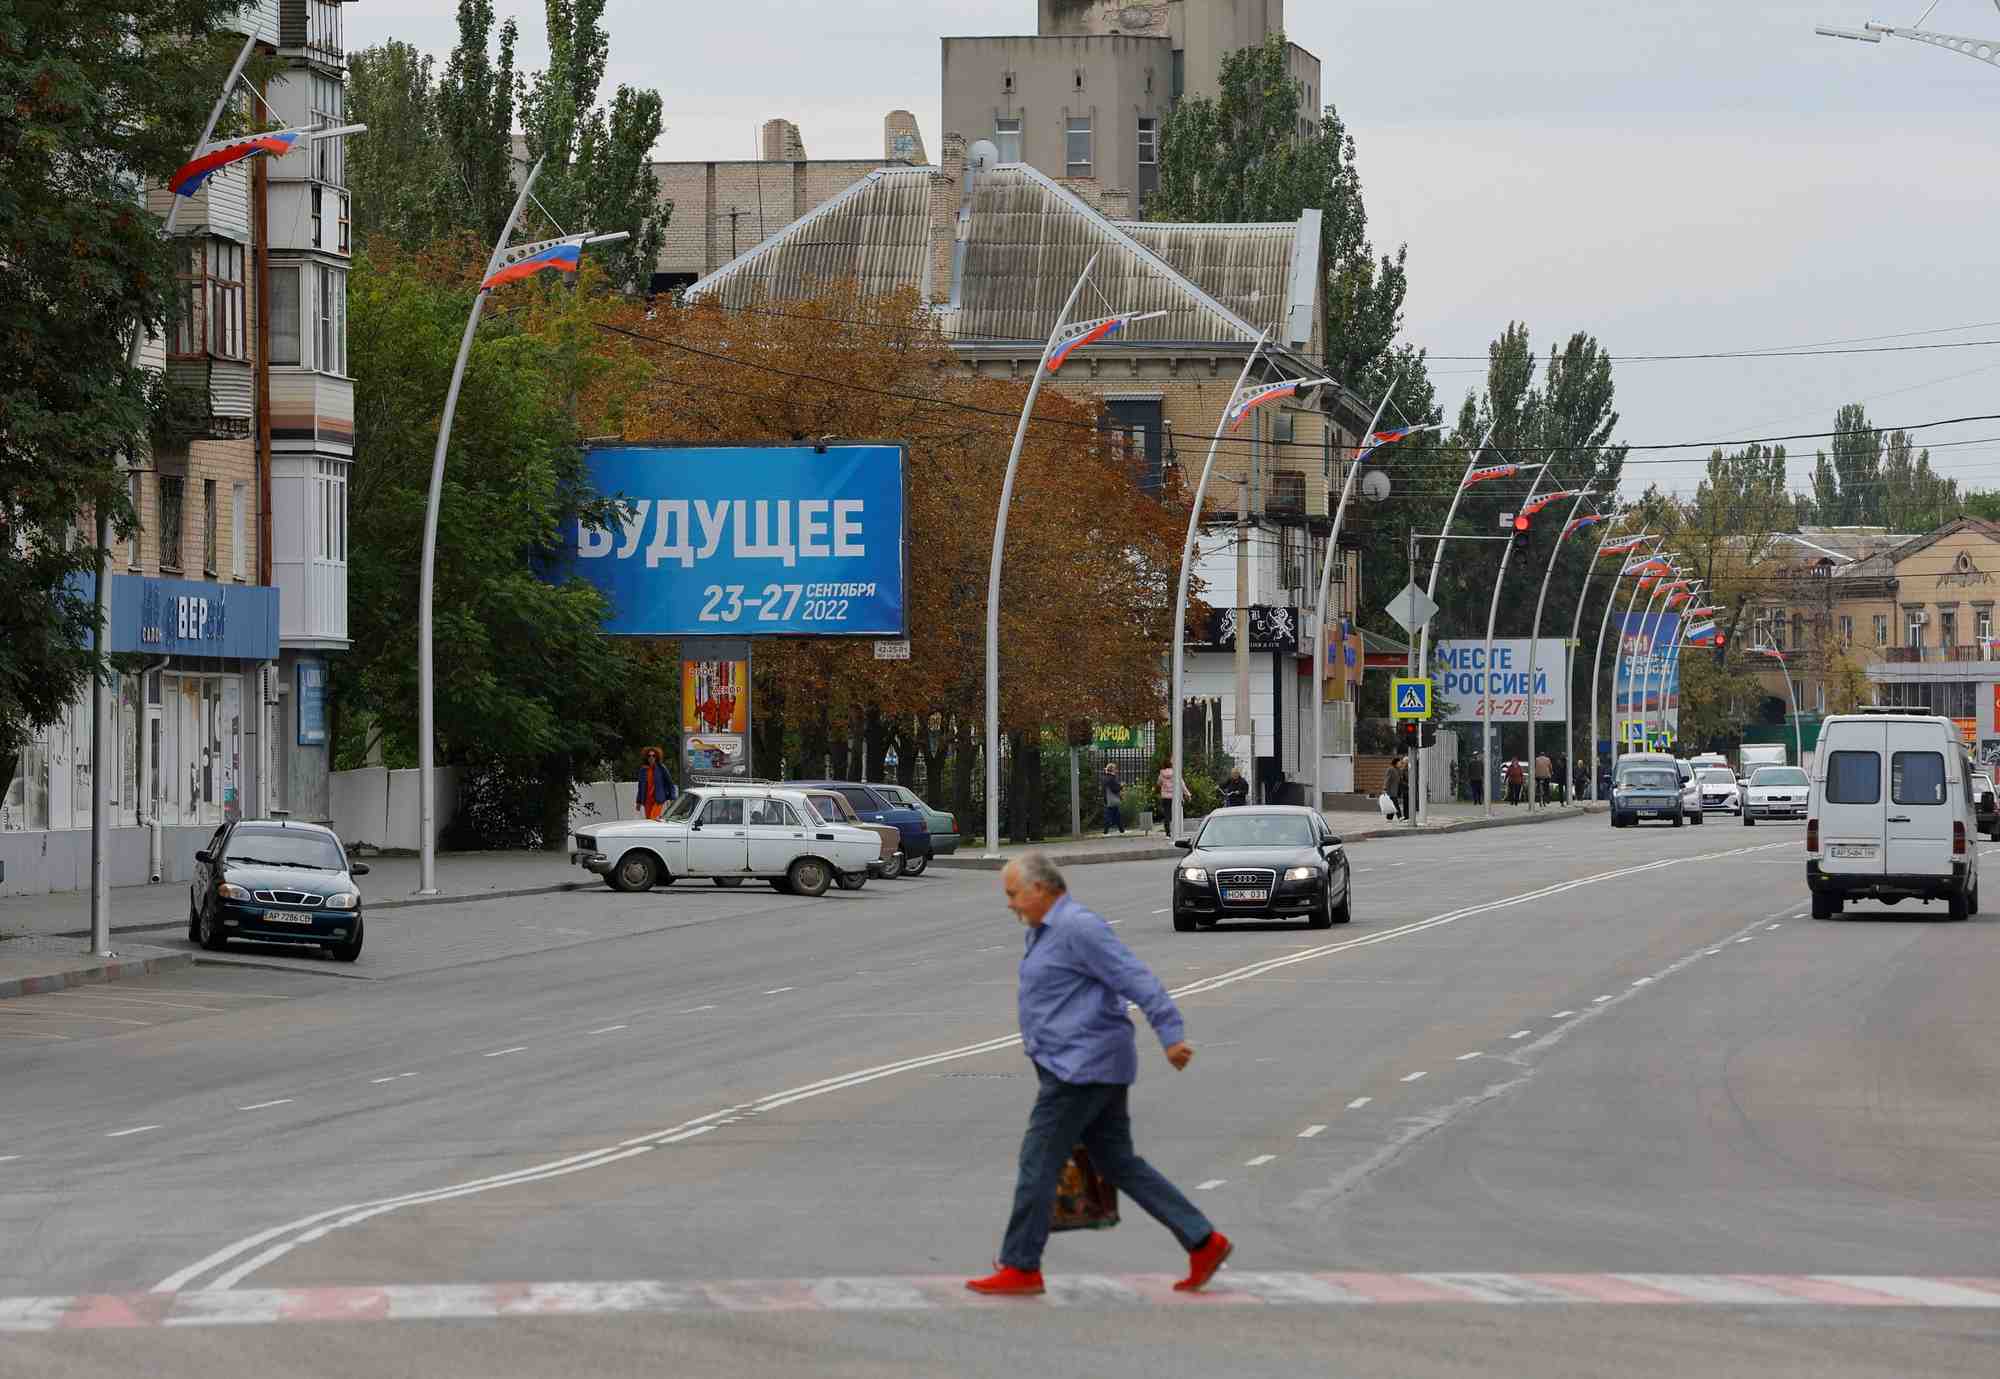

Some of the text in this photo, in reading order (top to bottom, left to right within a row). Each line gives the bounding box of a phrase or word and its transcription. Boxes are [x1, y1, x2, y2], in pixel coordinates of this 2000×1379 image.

[806, 583, 876, 598] СЕНТЯБРЯ
[802, 600, 849, 620] 2022
[1437, 648, 1512, 670] МЕСТЕ
[1444, 667, 1546, 695] РОССИЕЙ
